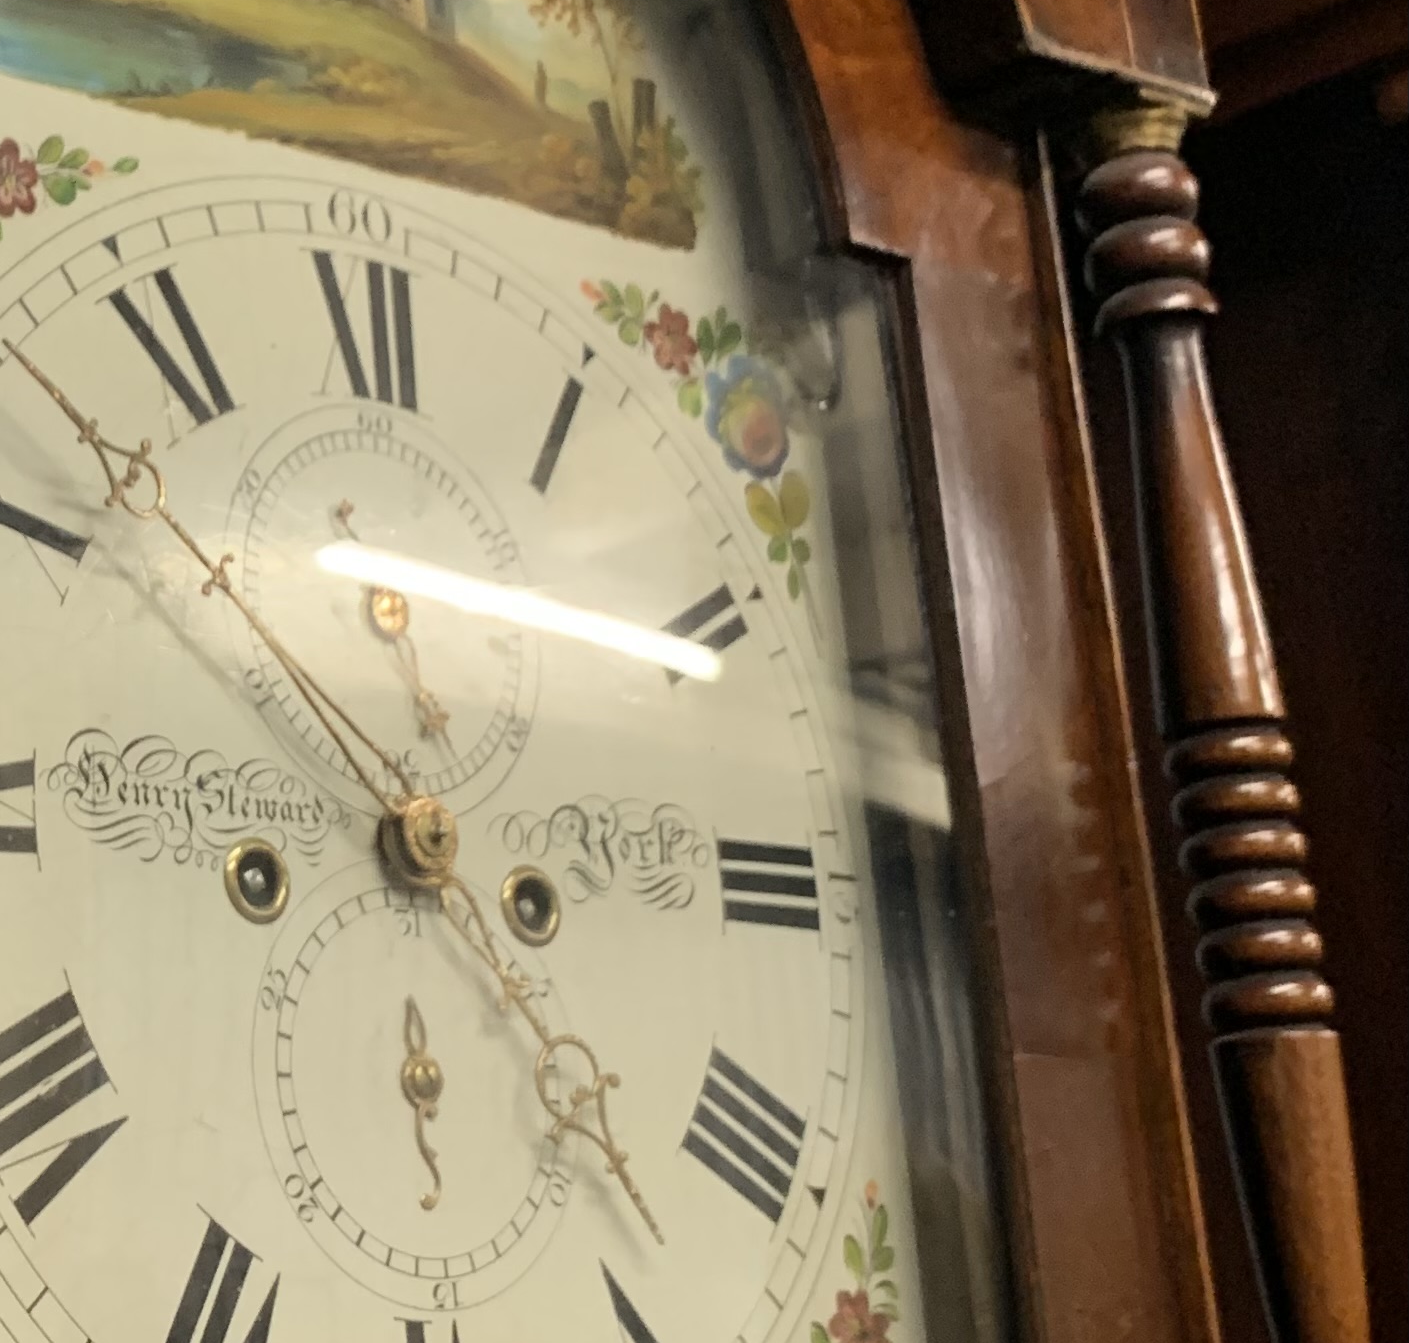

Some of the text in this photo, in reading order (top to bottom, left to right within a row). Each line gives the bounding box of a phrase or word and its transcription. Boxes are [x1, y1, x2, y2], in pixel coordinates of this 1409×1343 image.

[327, 187, 393, 244] 60
[298, 245, 434, 422] XII
[711, 827, 823, 949] III
[260, 967, 286, 1011] 25
[284, 1172, 320, 1224] 20
[432, 1280, 463, 1310] 15
